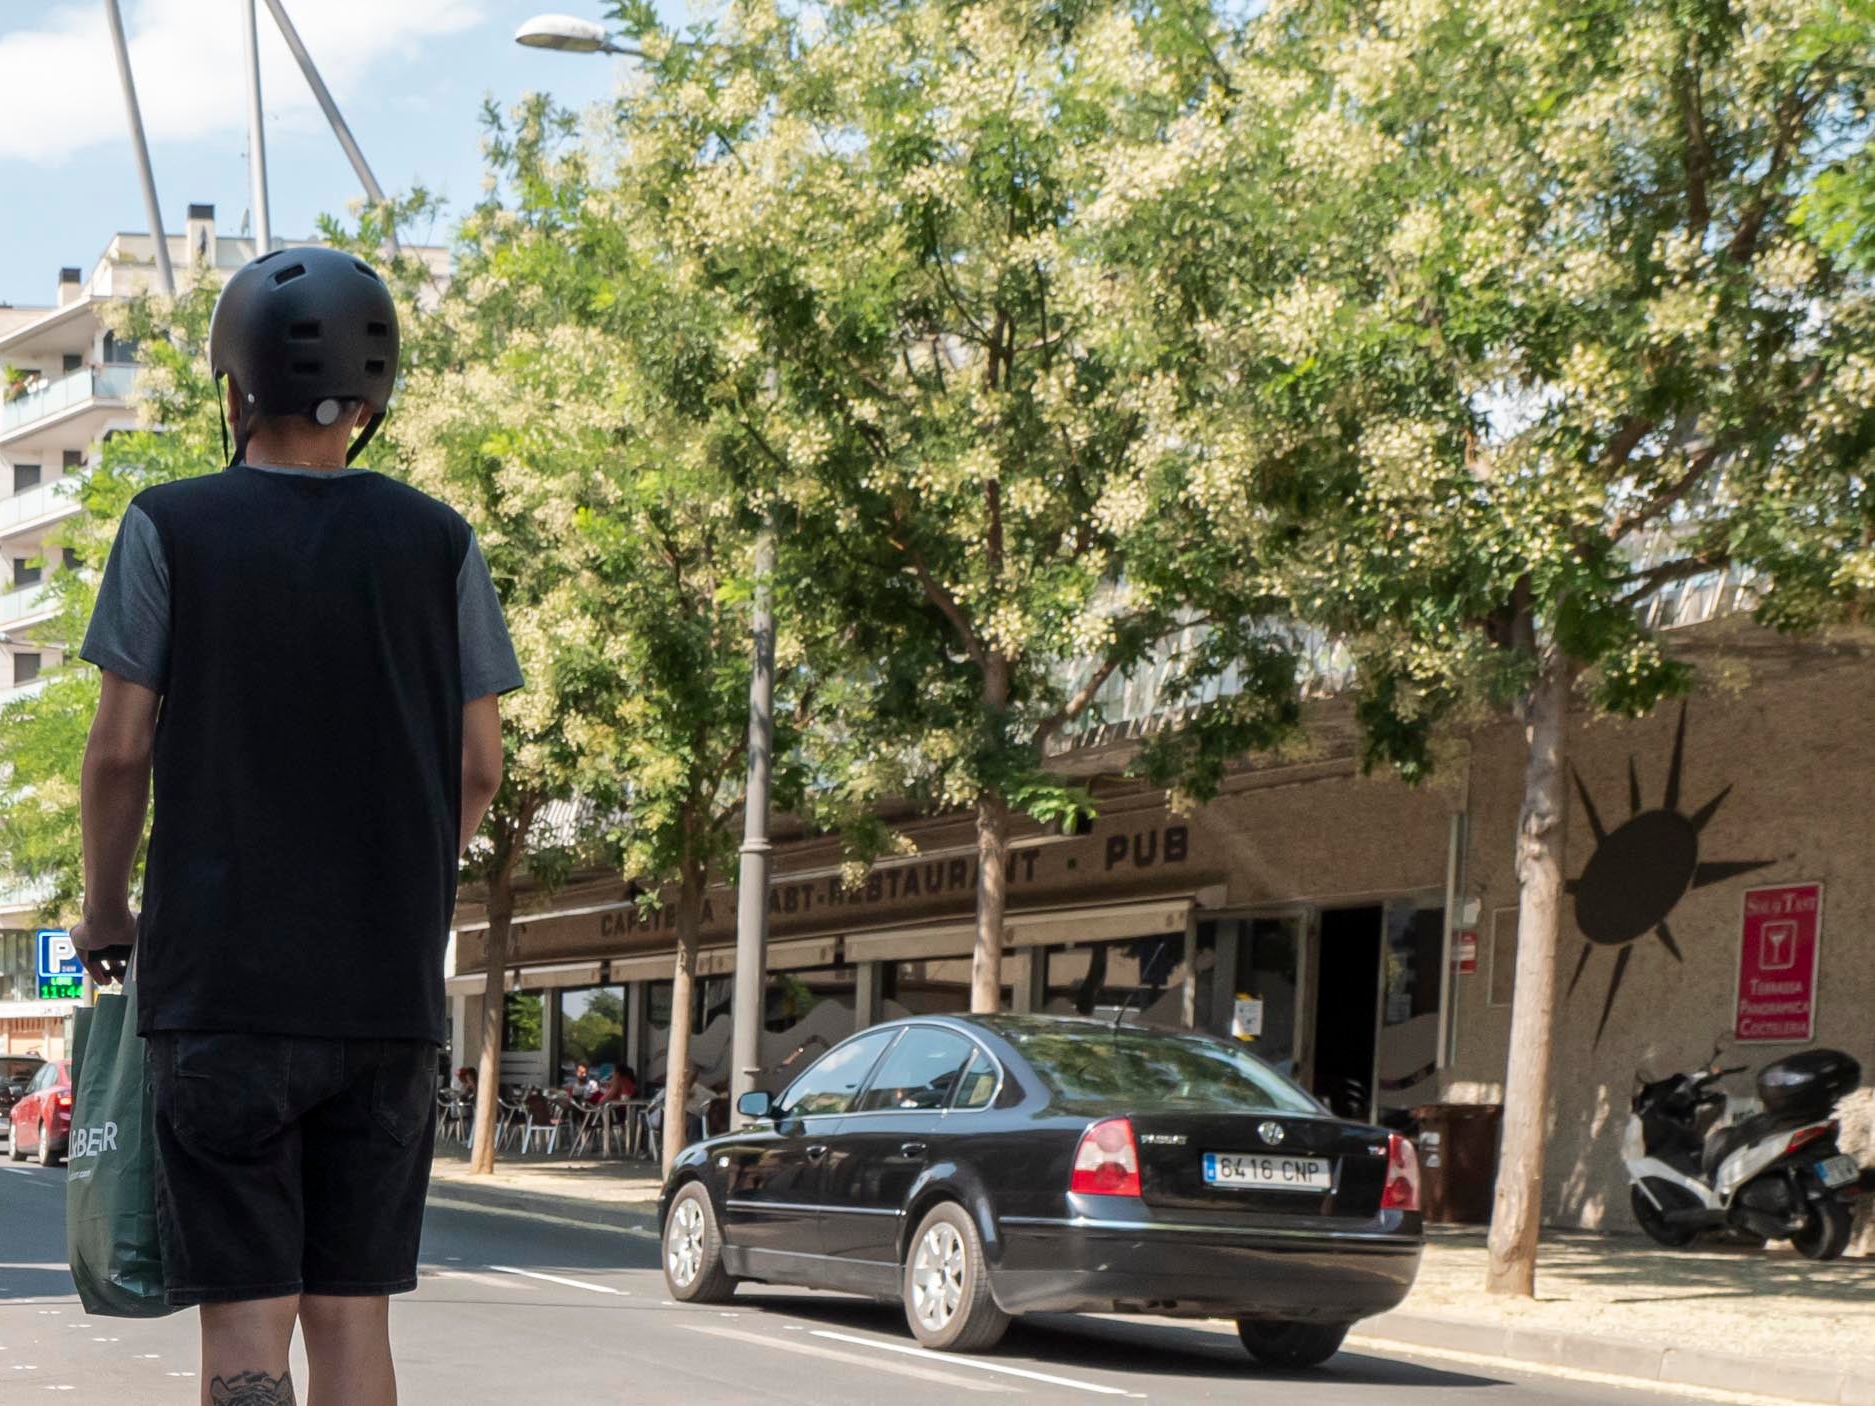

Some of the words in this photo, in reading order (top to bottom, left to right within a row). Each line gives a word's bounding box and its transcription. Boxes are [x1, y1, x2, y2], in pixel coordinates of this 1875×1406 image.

[600, 897, 715, 937] CAFETEA
[1104, 826, 1189, 871] PUB
[48, 936, 77, 974] P
[41, 985, 84, 999] 11:44
[1282, 1160, 1320, 1183] CNP
